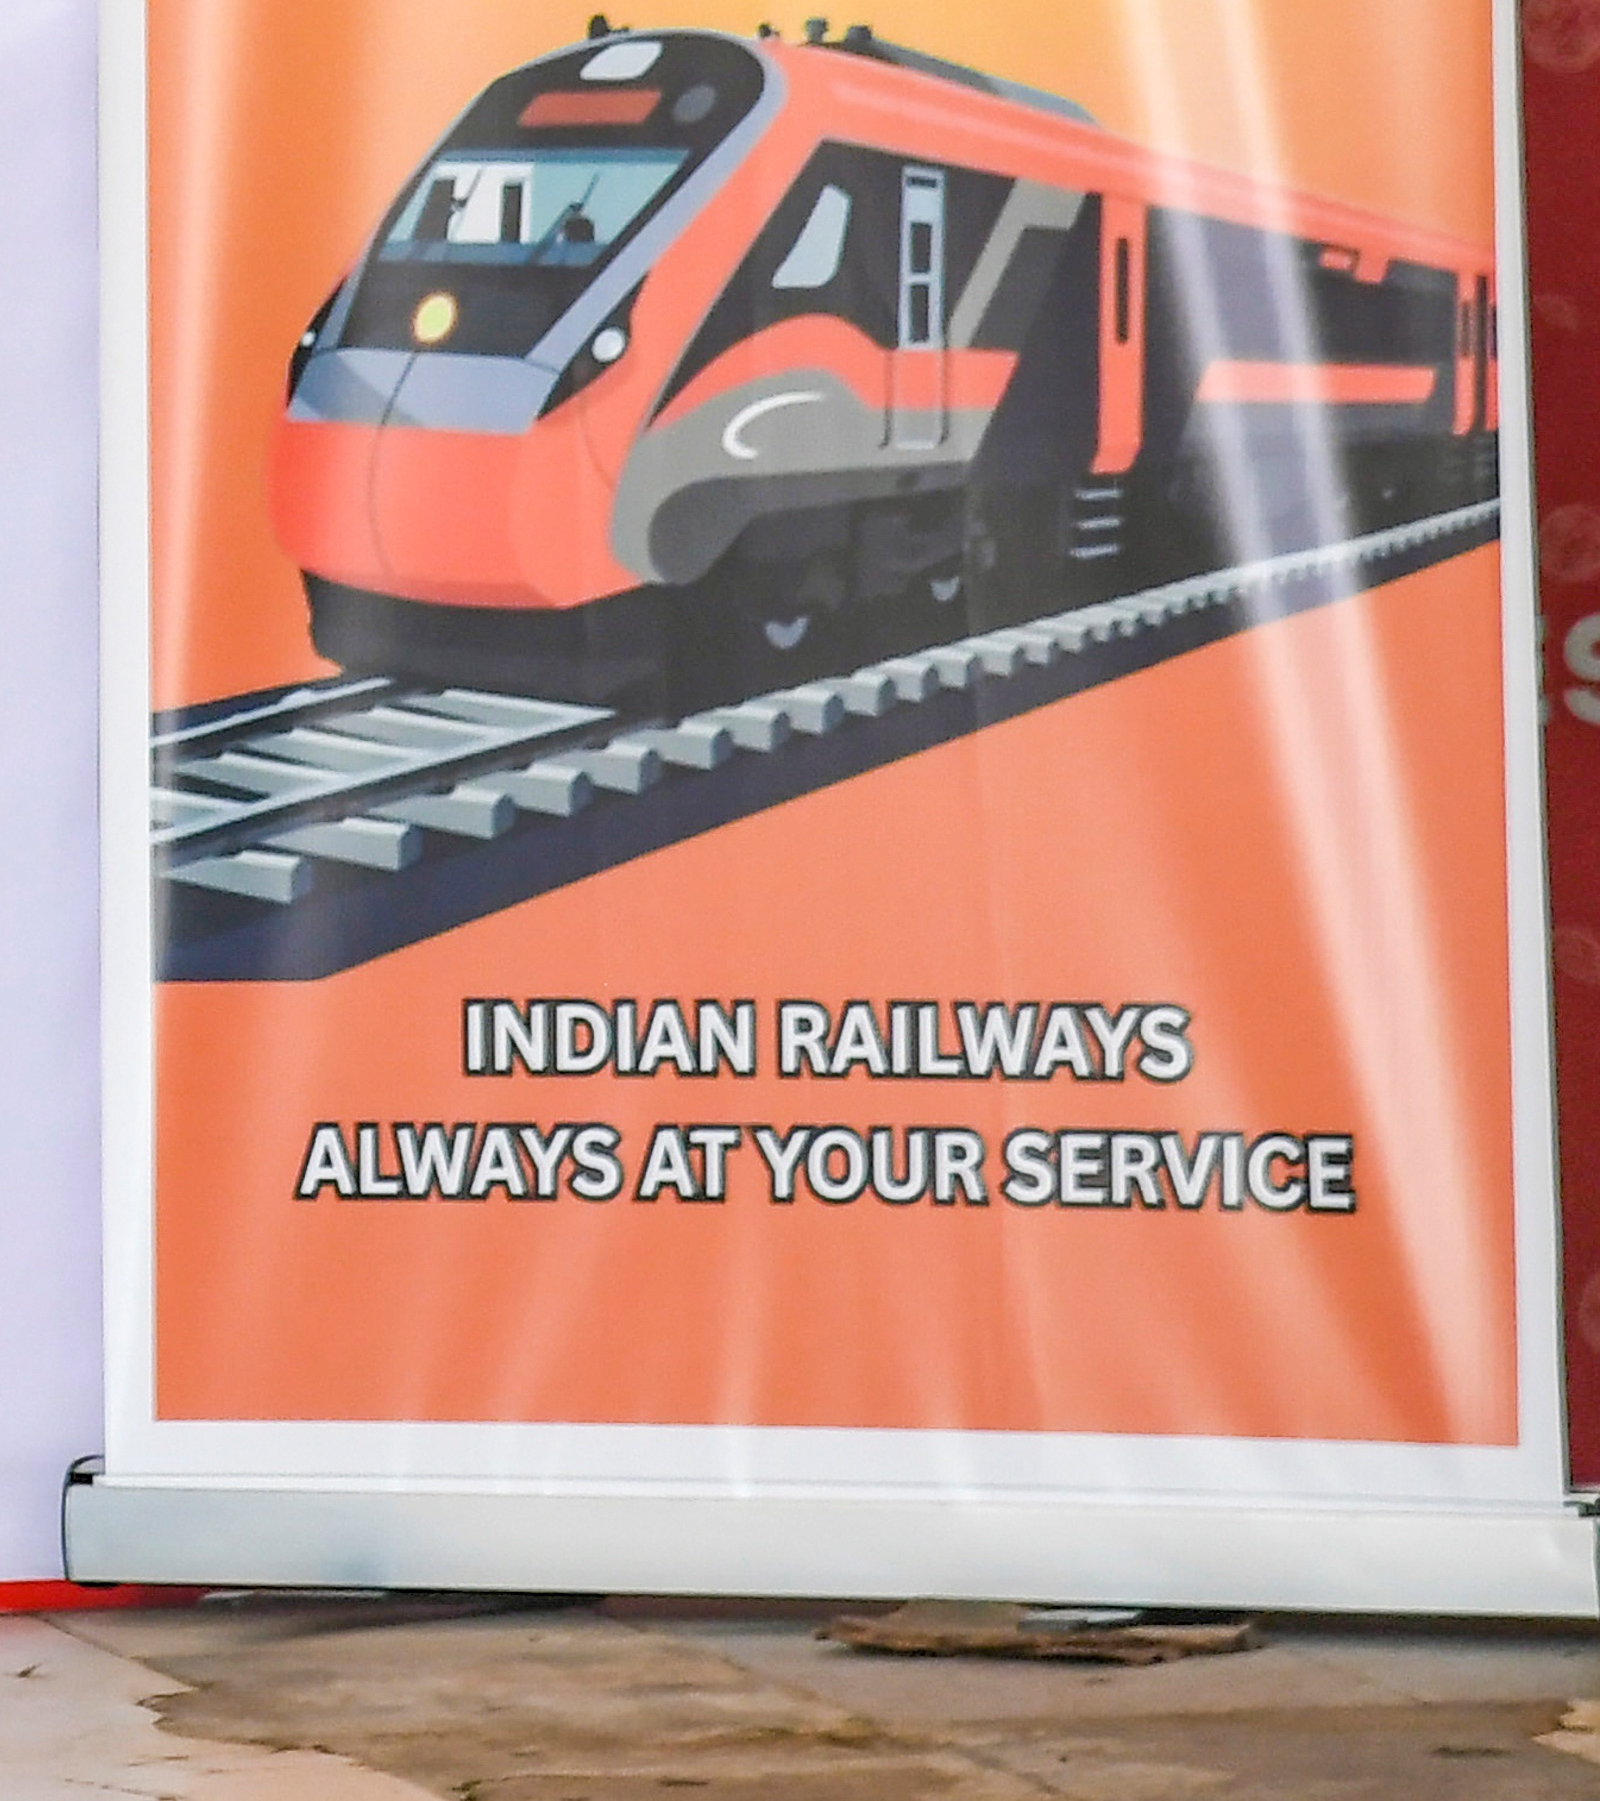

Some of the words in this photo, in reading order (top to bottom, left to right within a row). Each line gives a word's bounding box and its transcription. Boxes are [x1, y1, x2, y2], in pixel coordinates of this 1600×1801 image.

[463, 998, 755, 1077] INDIAN
[779, 1002, 1194, 1083] RAILWAYS
[294, 1122, 624, 1201] ALWAYS
[637, 1125, 742, 1202] AT
[752, 1125, 991, 1203] YOUR
[1001, 1129, 1356, 1214] SERVICE
